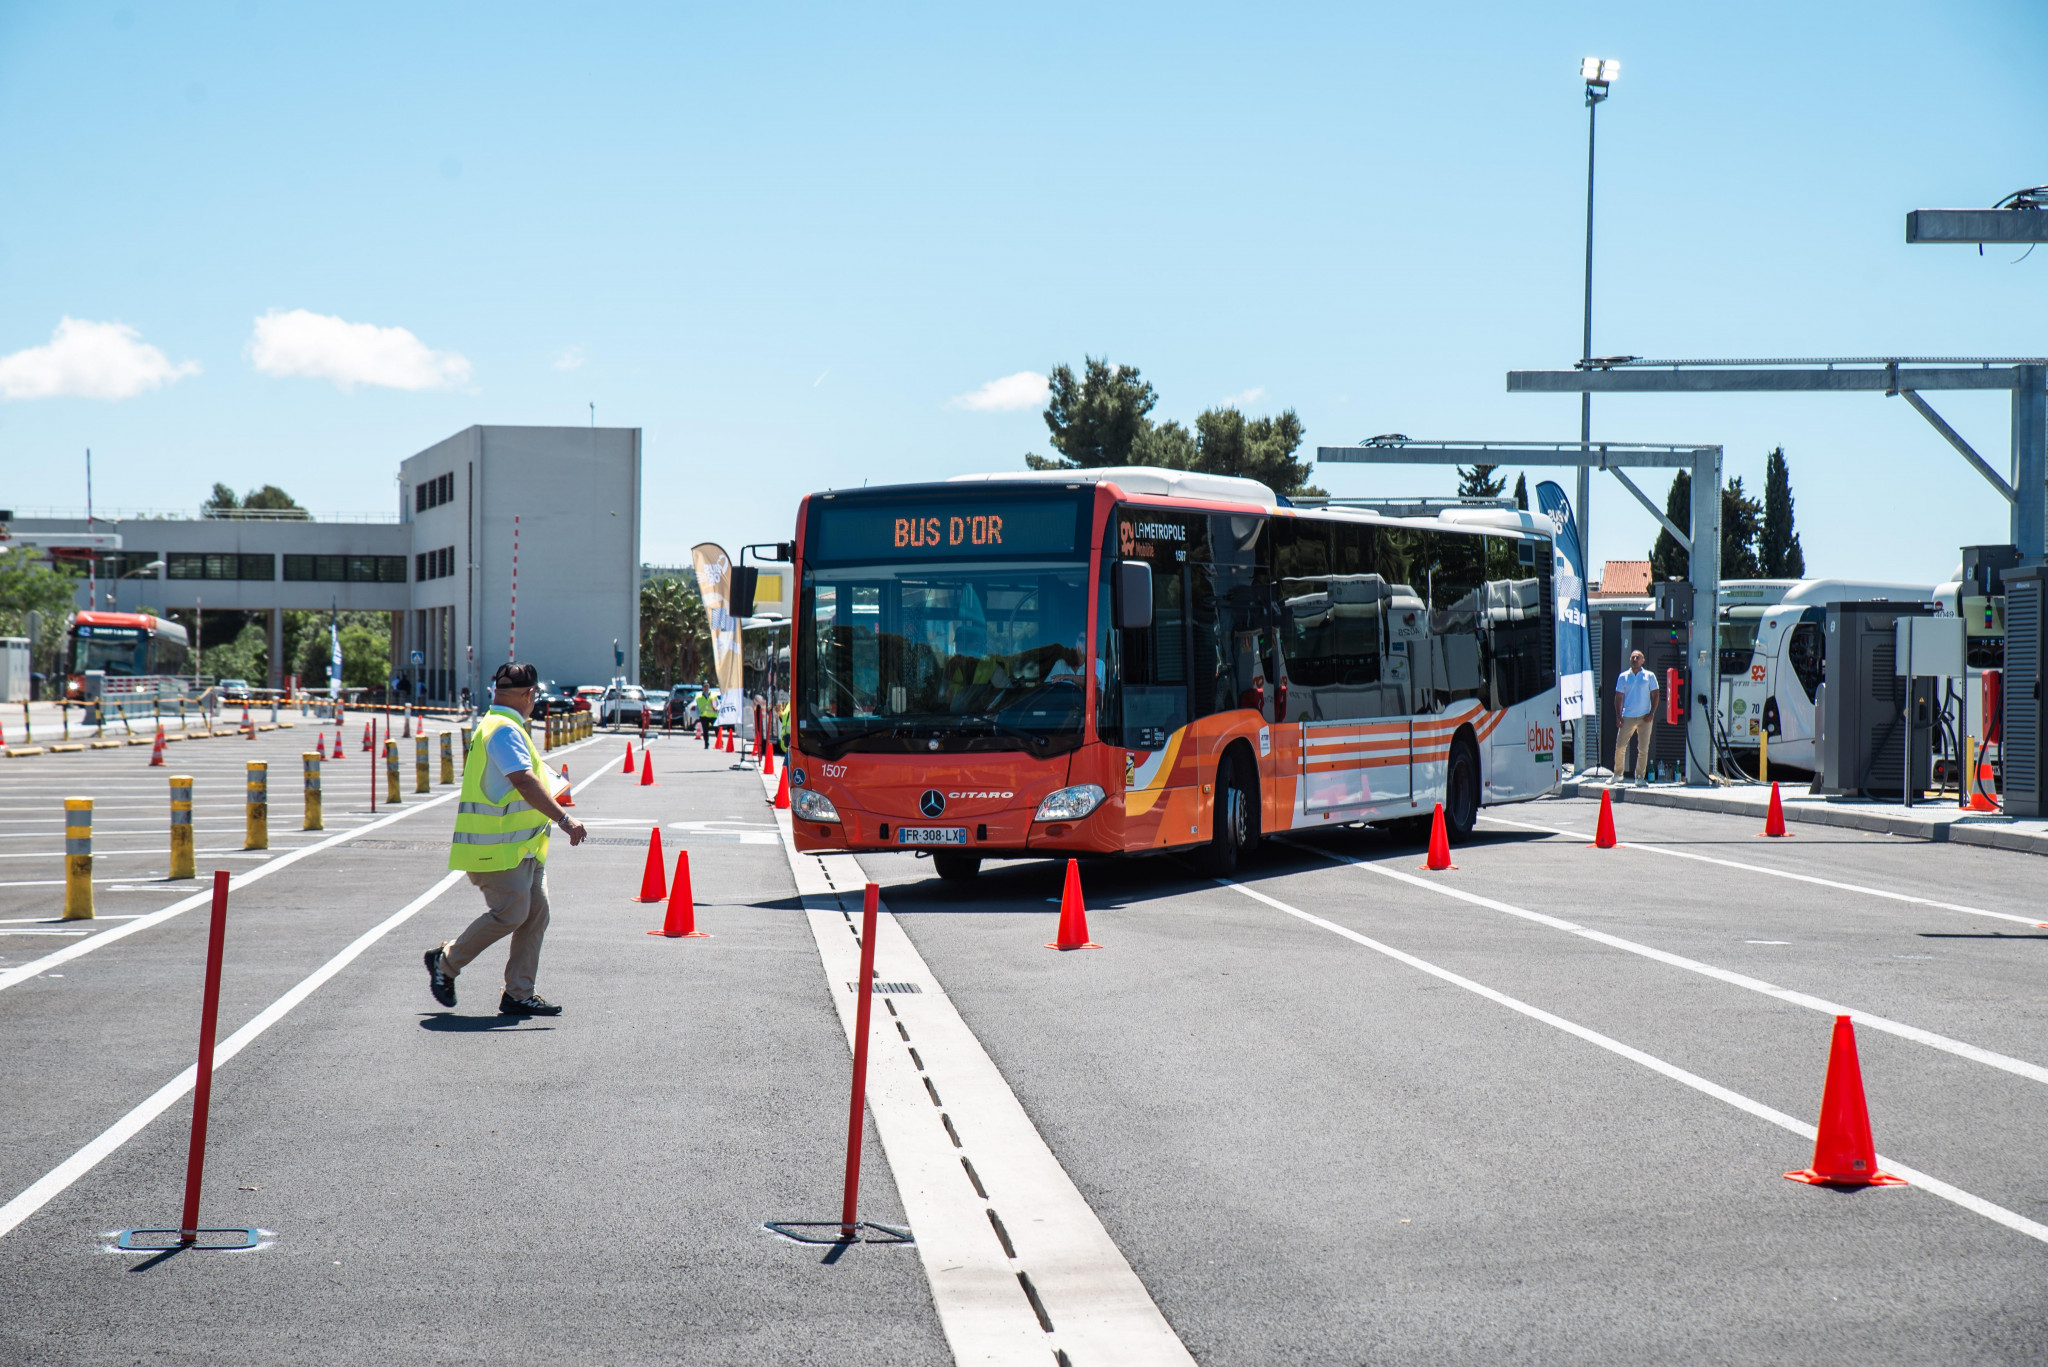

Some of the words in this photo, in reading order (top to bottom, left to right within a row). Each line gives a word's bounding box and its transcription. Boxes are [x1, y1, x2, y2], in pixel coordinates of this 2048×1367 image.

[894, 517, 941, 548] BUS
[949, 515, 1003, 545] D'OR
[1175, 549, 1187, 562] 1507
[1751, 703, 1760, 715] 70
[821, 764, 848, 778] 1507
[948, 791, 1014, 799] CITARO
[906, 829, 959, 841] FR-308-LX
